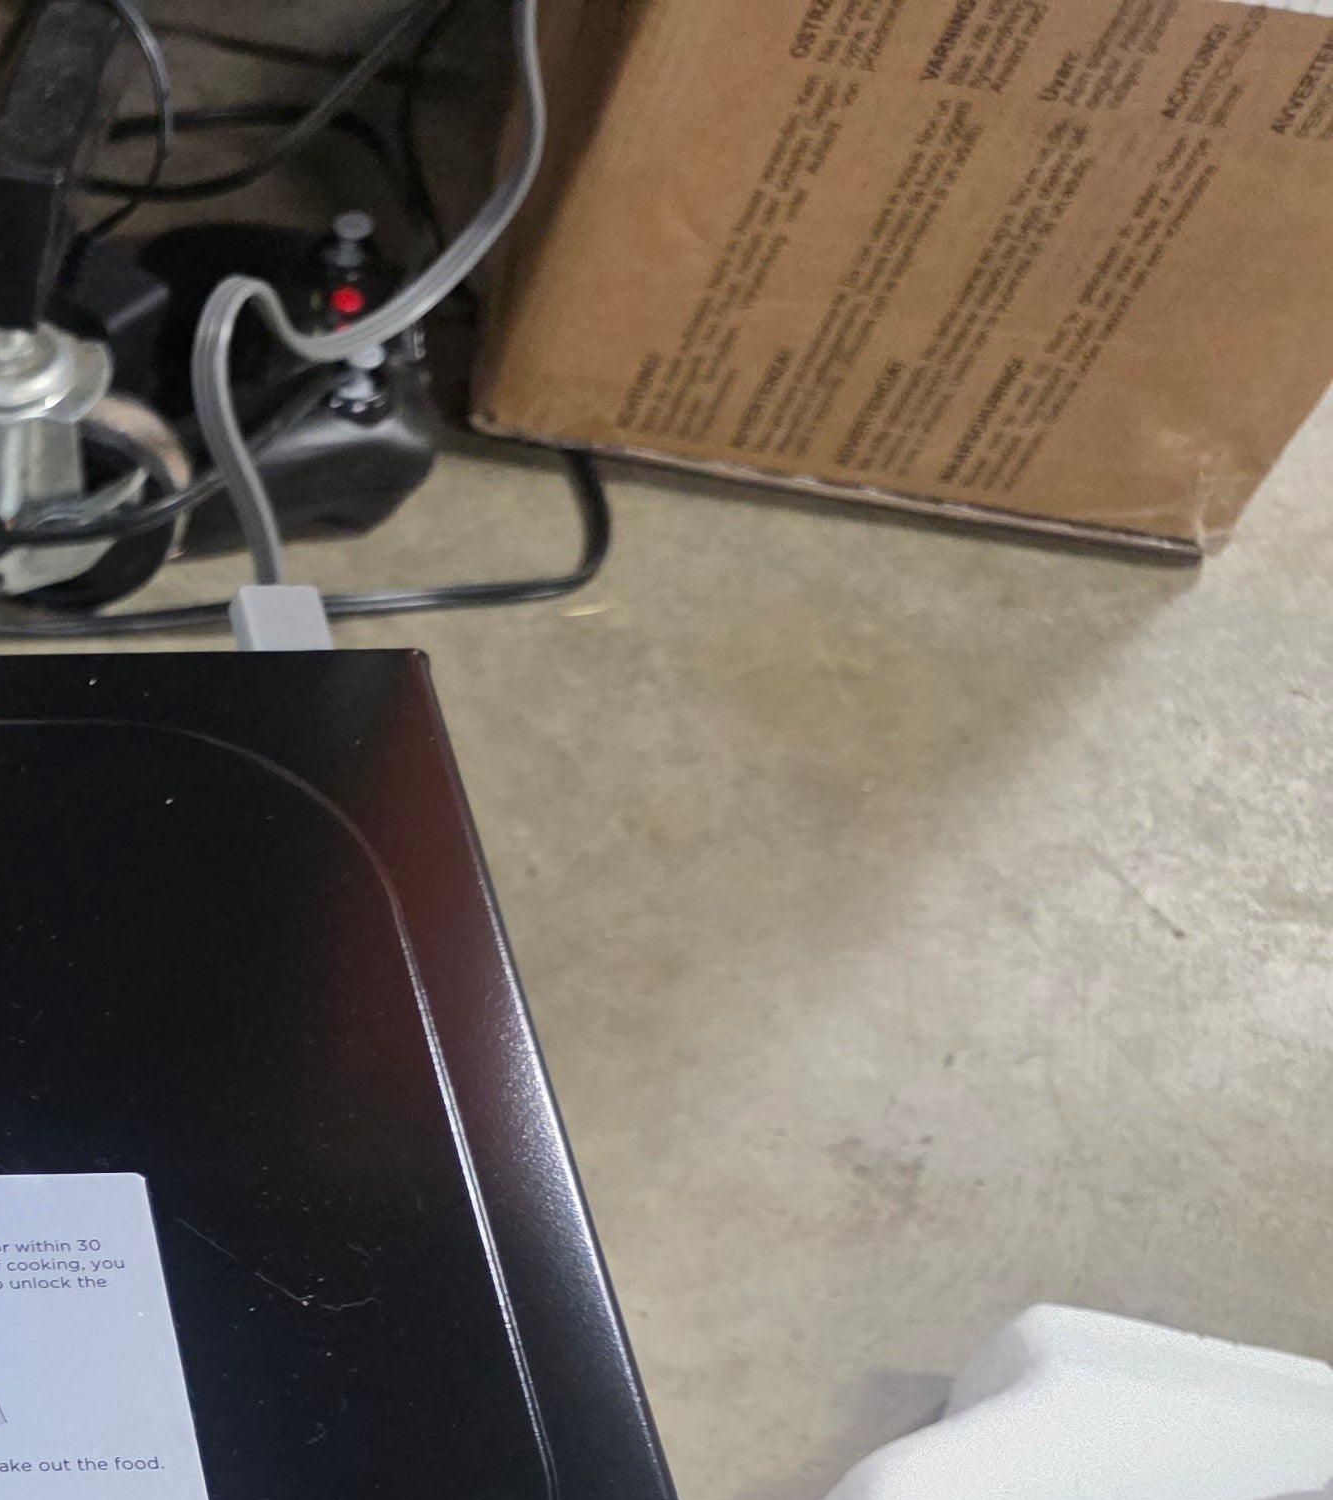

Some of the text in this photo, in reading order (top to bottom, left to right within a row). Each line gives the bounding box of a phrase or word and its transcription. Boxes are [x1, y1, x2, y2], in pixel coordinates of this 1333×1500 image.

[13, 1239, 71, 1253] within
[75, 1238, 101, 1252] 30
[5, 1258, 86, 1274] cooking,
[89, 1258, 126, 1273] you
[8, 1275, 71, 1290] unlock
[76, 1274, 107, 1288] the
[37, 1457, 71, 1472] out
[76, 1456, 109, 1471] the
[113, 1455, 165, 1471] food.
